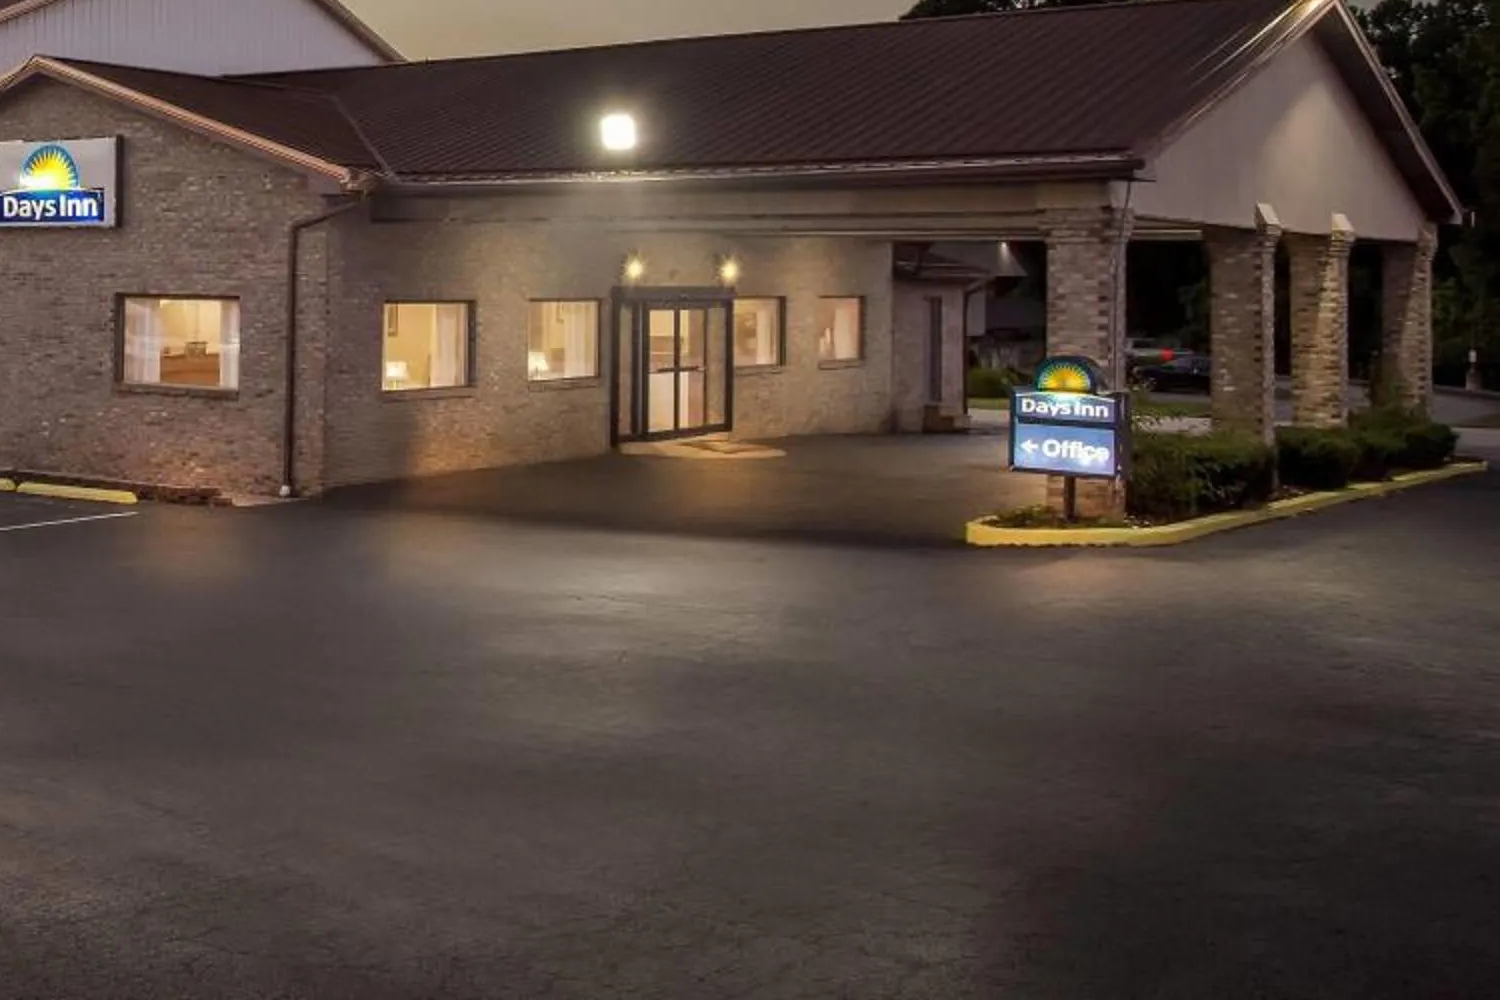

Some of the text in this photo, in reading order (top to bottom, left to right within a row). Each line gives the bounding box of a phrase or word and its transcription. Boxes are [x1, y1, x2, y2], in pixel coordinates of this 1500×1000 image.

[3, 195, 98, 220] Days Inn
[1021, 398, 1109, 417] Days Inn
[1042, 439, 1110, 462] Office
